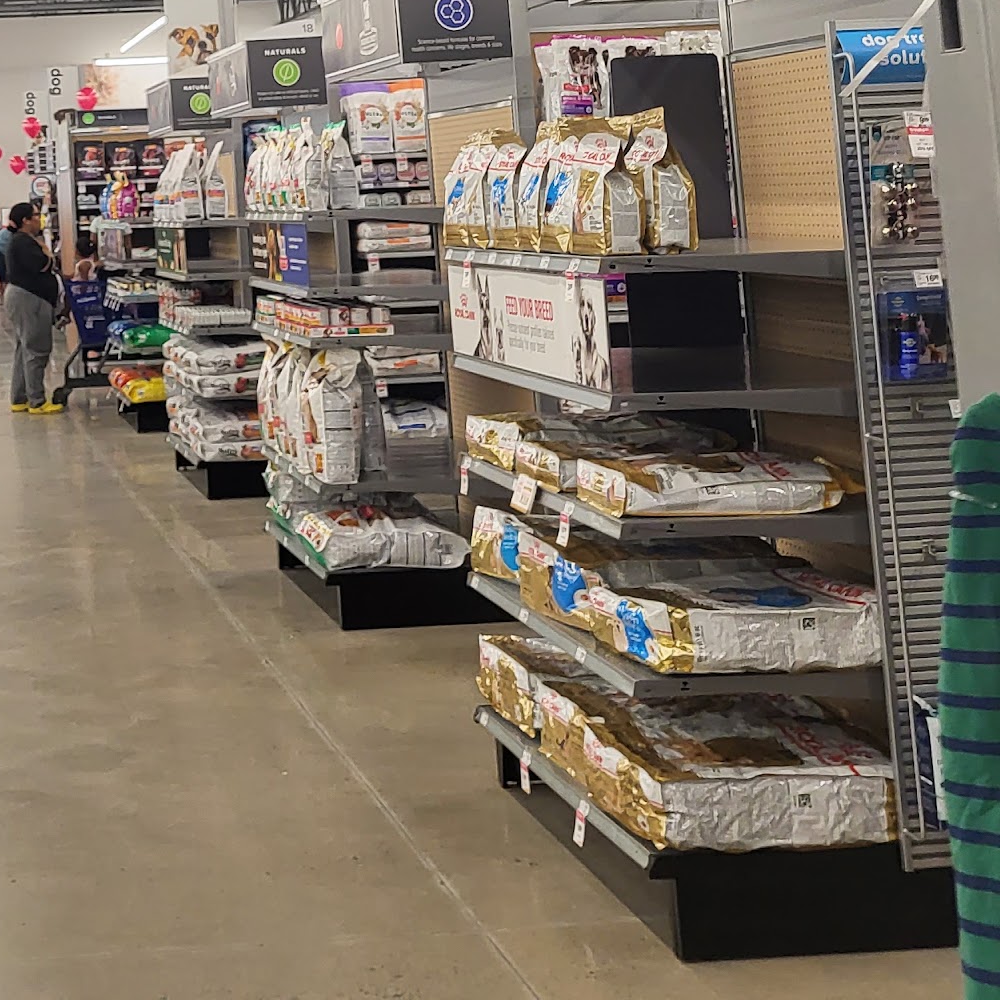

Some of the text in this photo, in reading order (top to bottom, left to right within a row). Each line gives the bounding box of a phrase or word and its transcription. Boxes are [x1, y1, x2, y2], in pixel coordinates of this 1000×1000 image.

[302, 23, 314, 33] 18
[264, 46, 307, 57] NATURALS
[49, 68, 63, 95] dog
[25, 91, 36, 115] dog
[505, 295, 554, 321] FEED YOUR BREED
